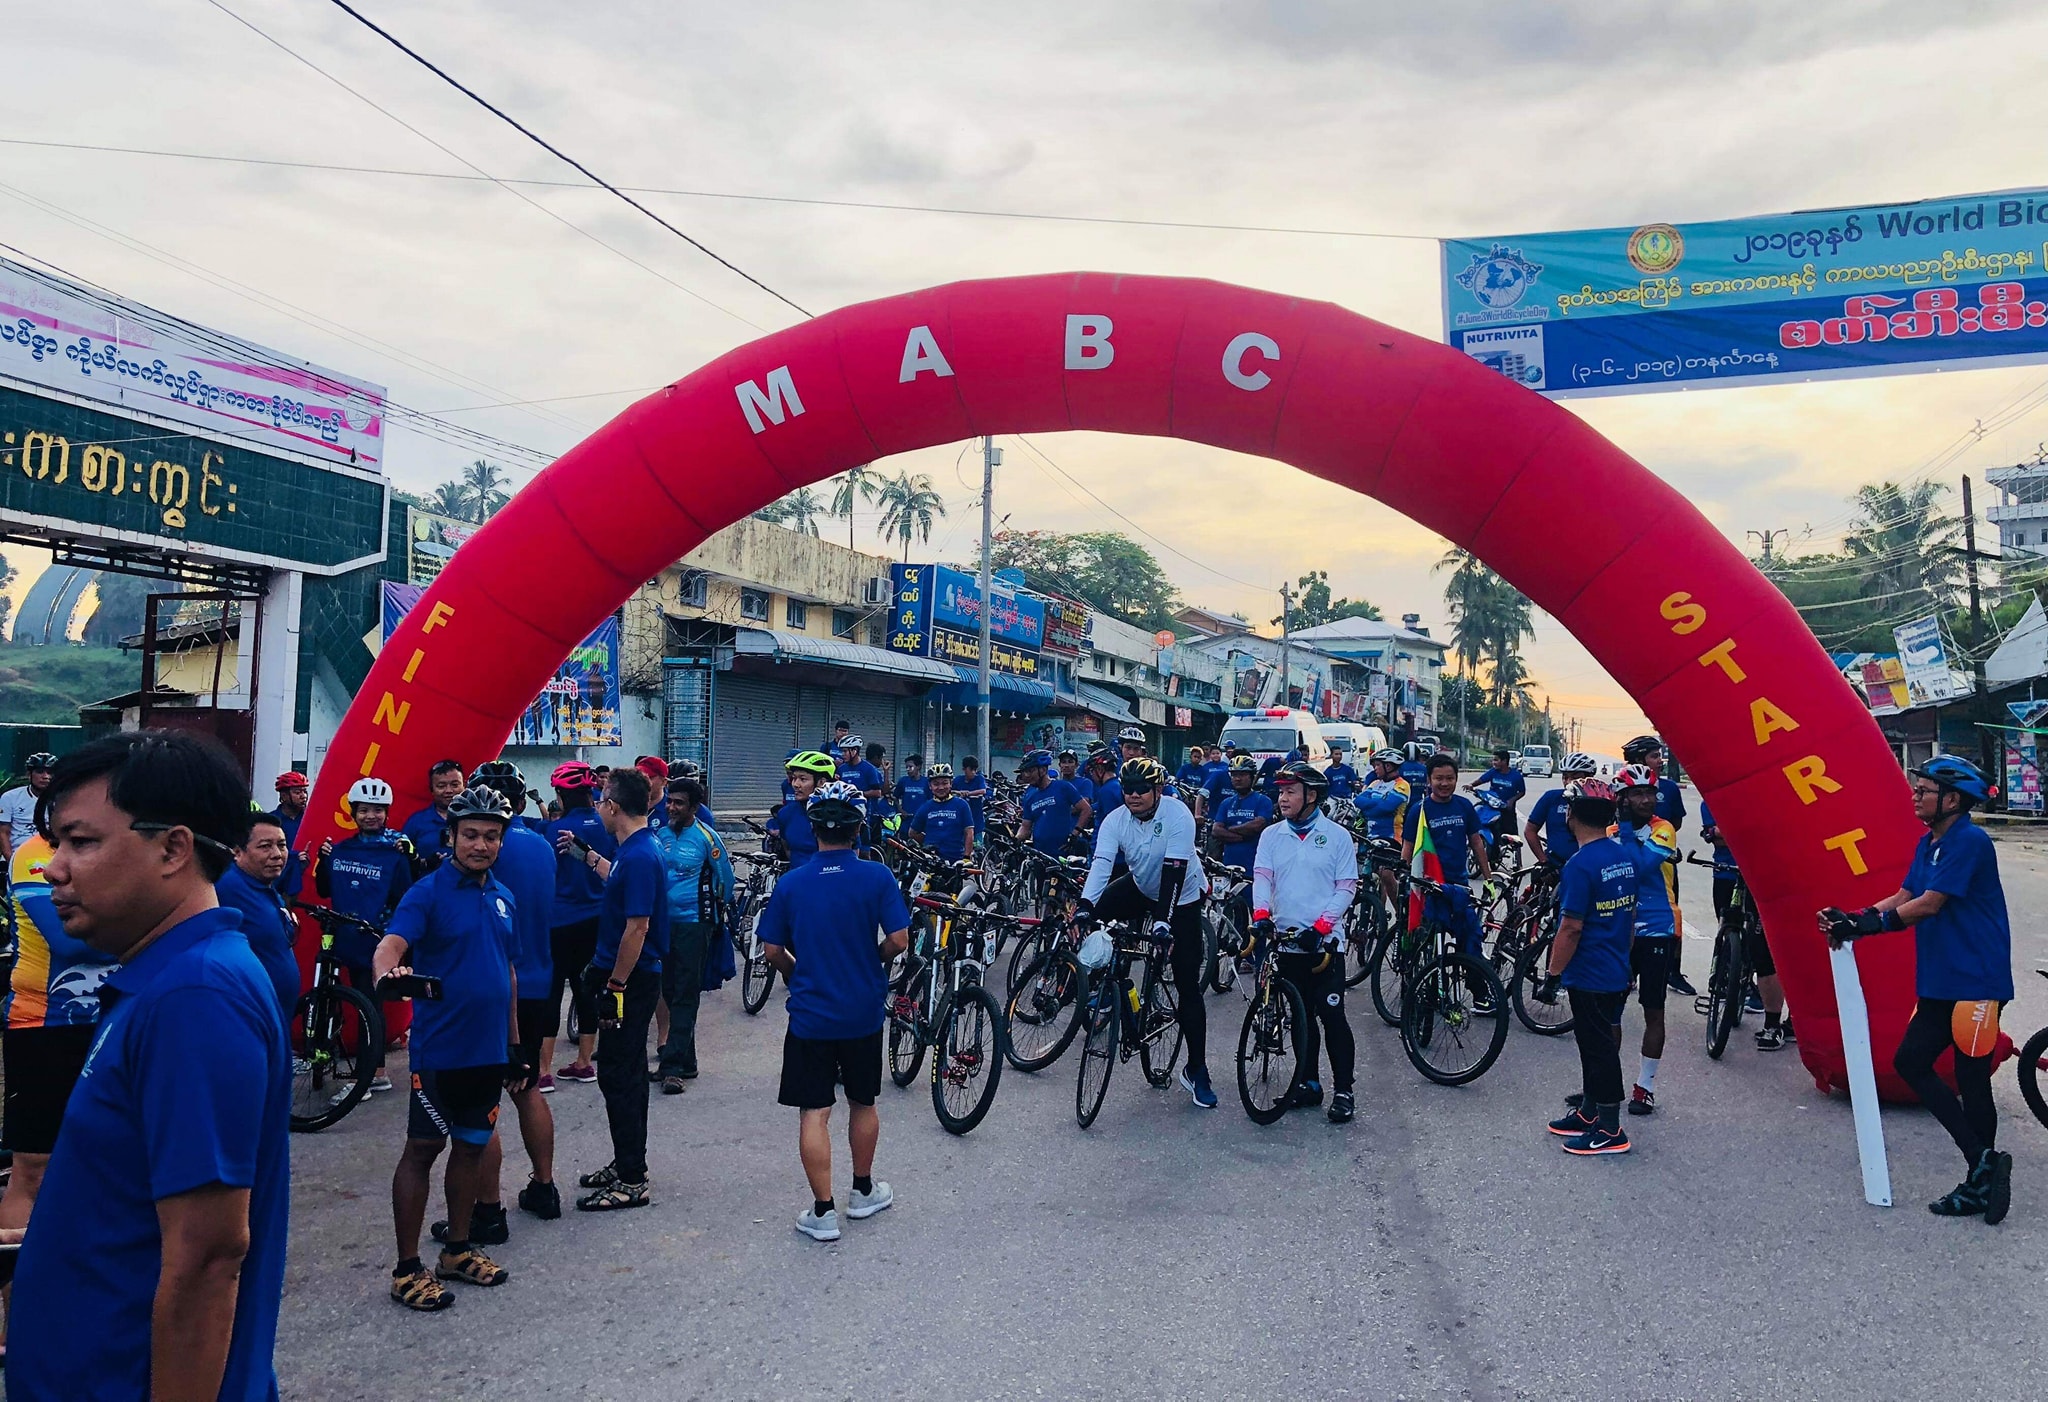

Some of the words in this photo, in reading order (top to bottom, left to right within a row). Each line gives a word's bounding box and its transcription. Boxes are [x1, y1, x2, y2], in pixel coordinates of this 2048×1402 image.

[1877, 203, 1984, 240] World
[1456, 306, 1548, 325] #June3WorldBicycleDay
[1779, 282, 2048, 349] စက်ဘီးစီး
[1466, 328, 1539, 344] NUTRIVITA
[734, 313, 1281, 435] MABC
[312, 600, 455, 878] FINIS
[1659, 591, 1869, 876] START
[340, 864, 381, 878] NUTRIVITA
[1971, 1000, 1989, 1022] MA
